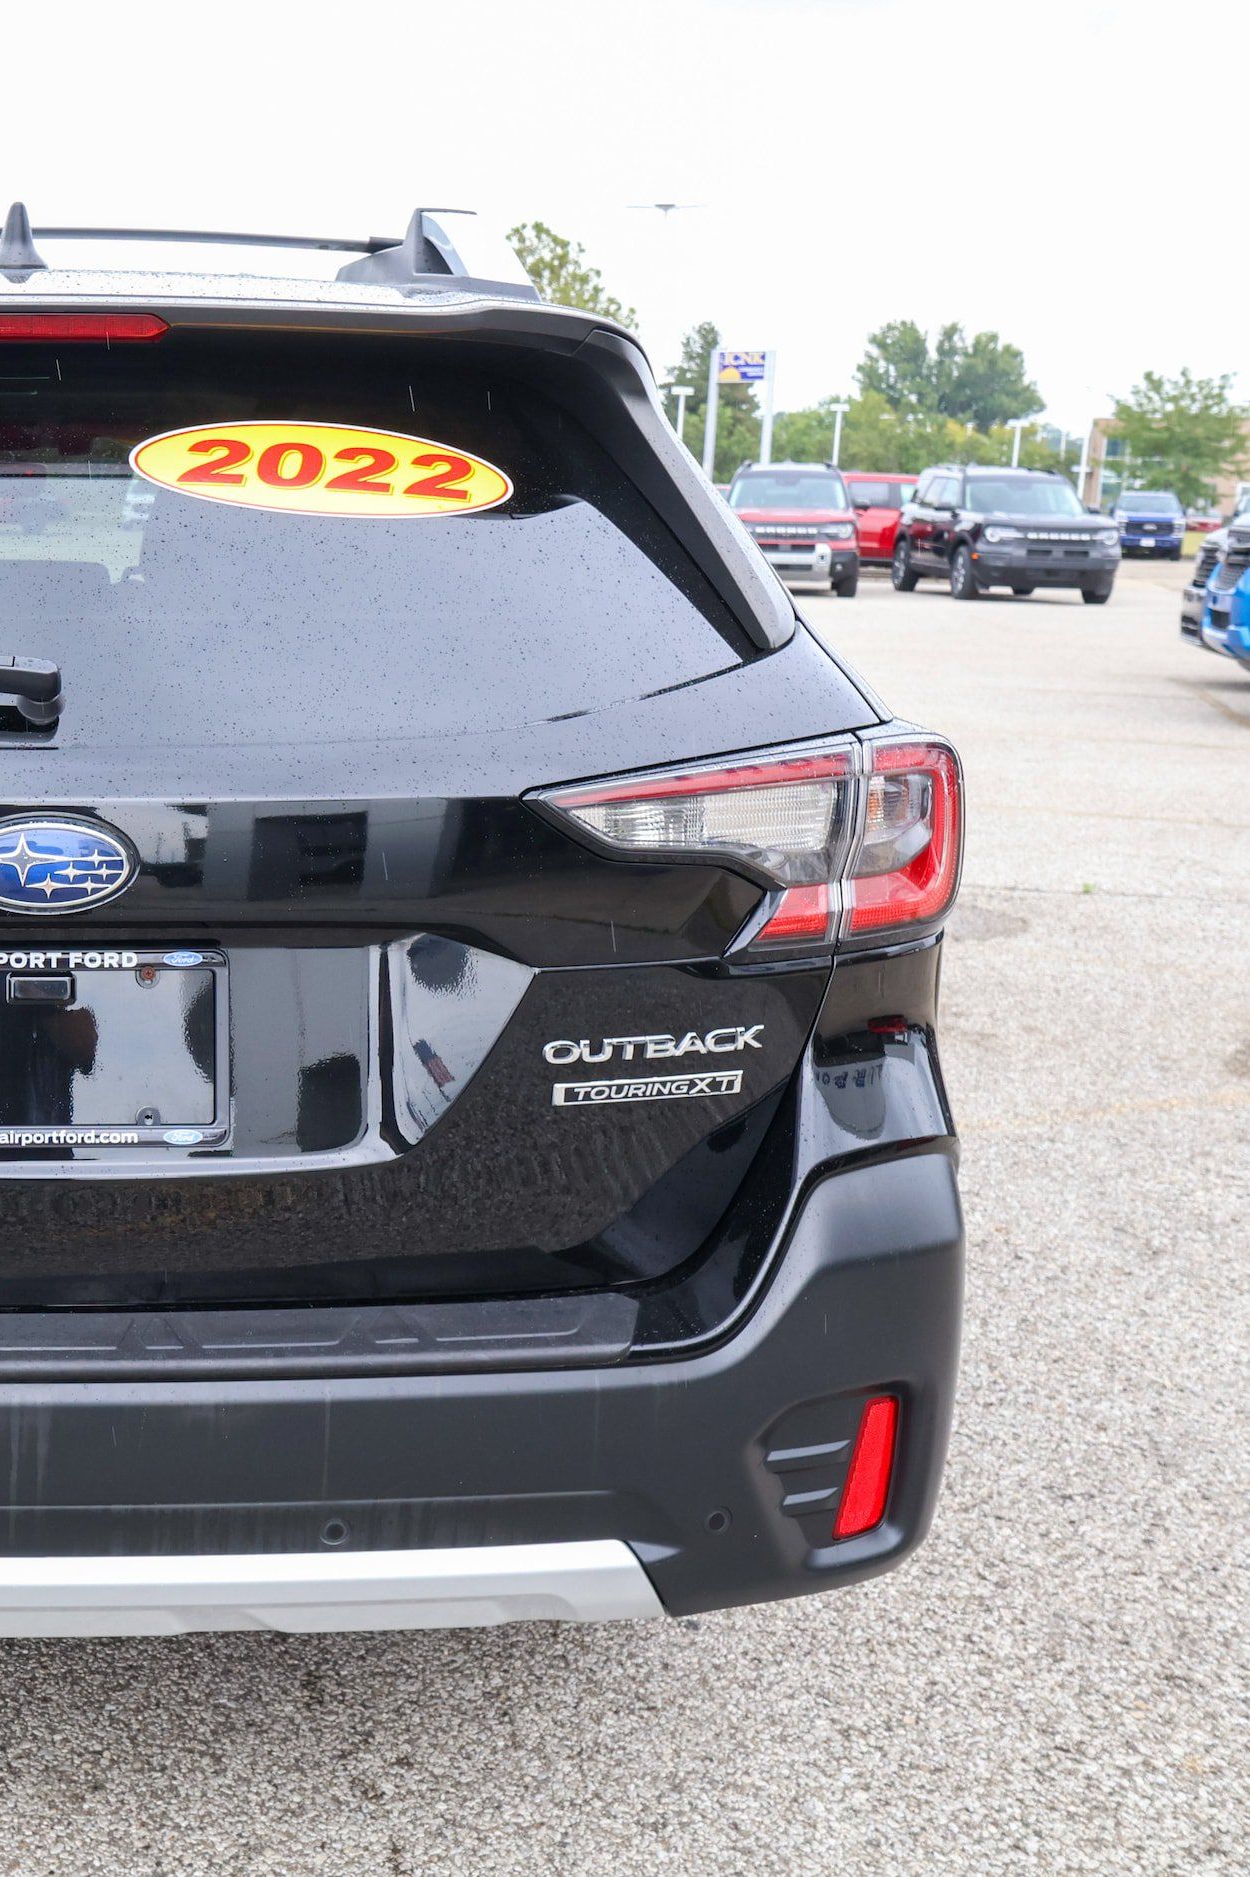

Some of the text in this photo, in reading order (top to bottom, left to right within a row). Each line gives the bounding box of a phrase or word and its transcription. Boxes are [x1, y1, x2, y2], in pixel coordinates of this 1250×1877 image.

[176, 439, 475, 503] 2022
[69, 952, 138, 968] FORD
[542, 1024, 765, 1064] OUTBACK
